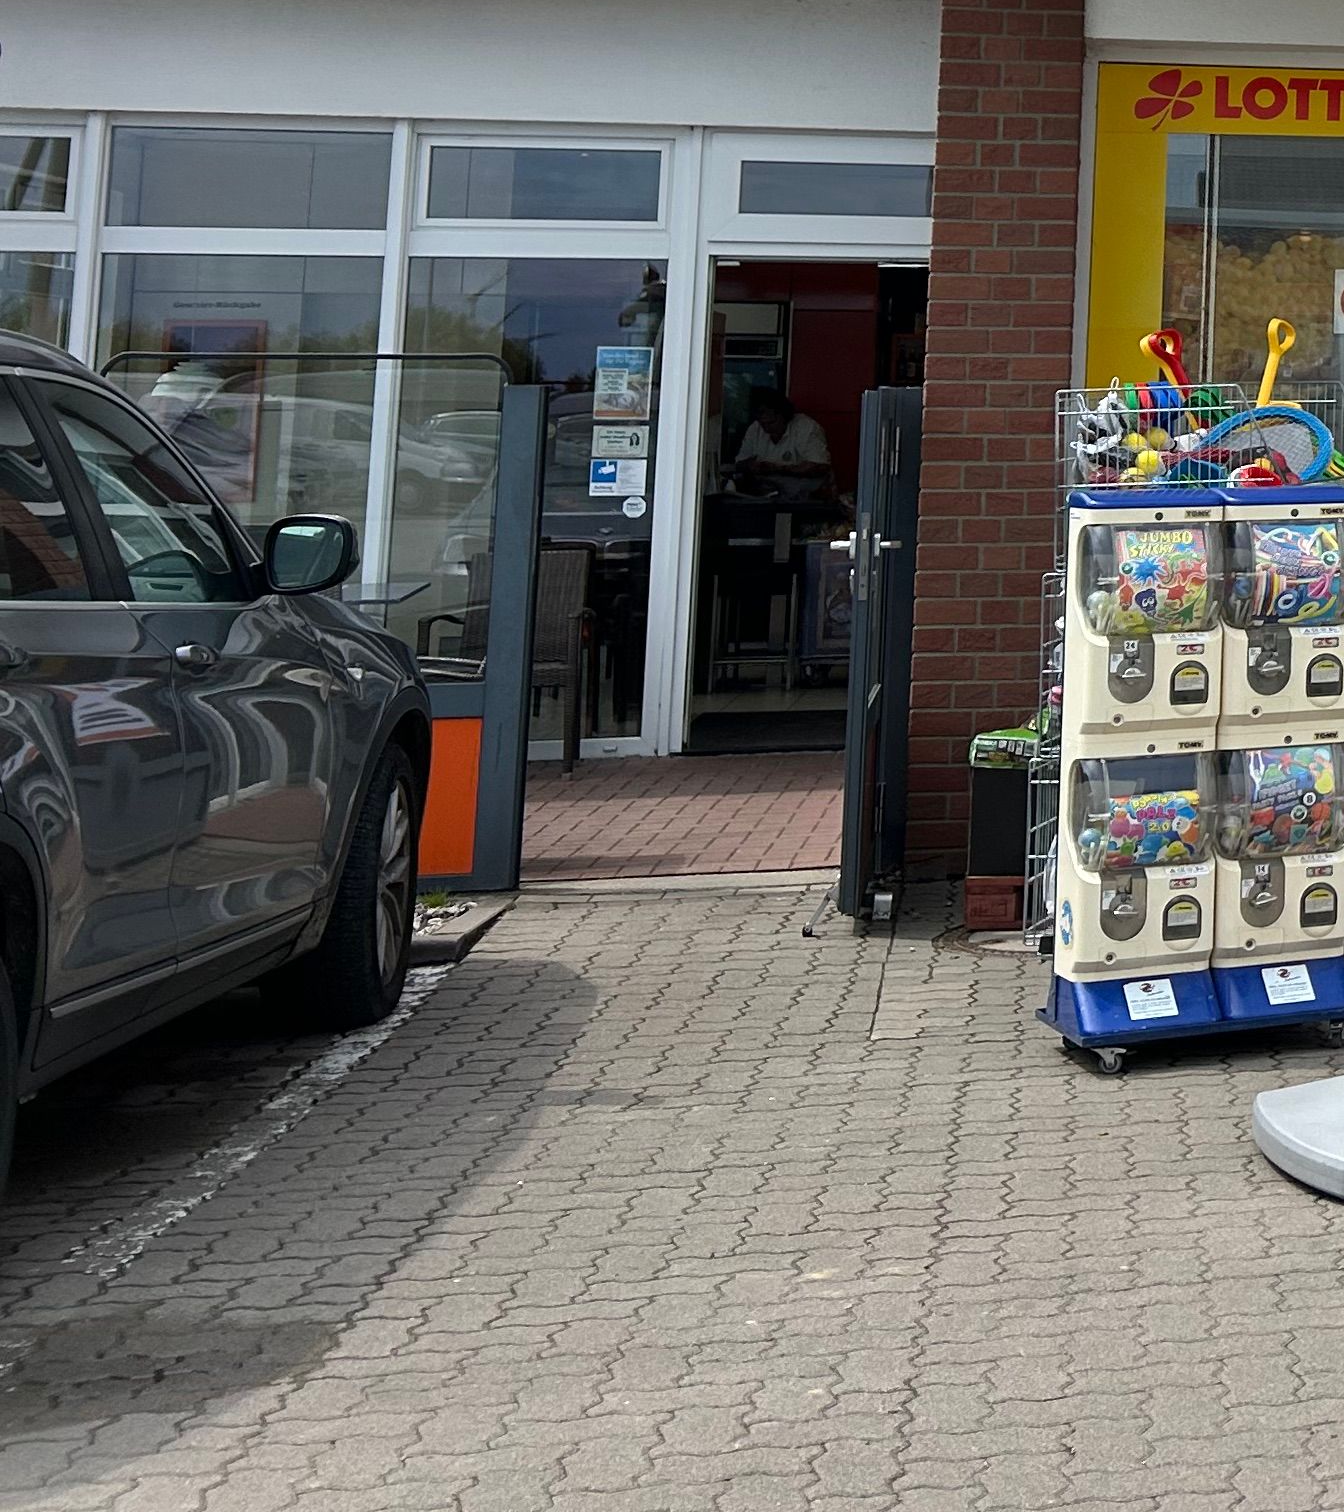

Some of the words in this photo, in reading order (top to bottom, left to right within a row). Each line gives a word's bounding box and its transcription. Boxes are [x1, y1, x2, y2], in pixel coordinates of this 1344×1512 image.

[1139, 530, 1193, 544] JUMBO
[1129, 543, 1175, 558] STICKY
[1178, 740, 1204, 749] TOMY
